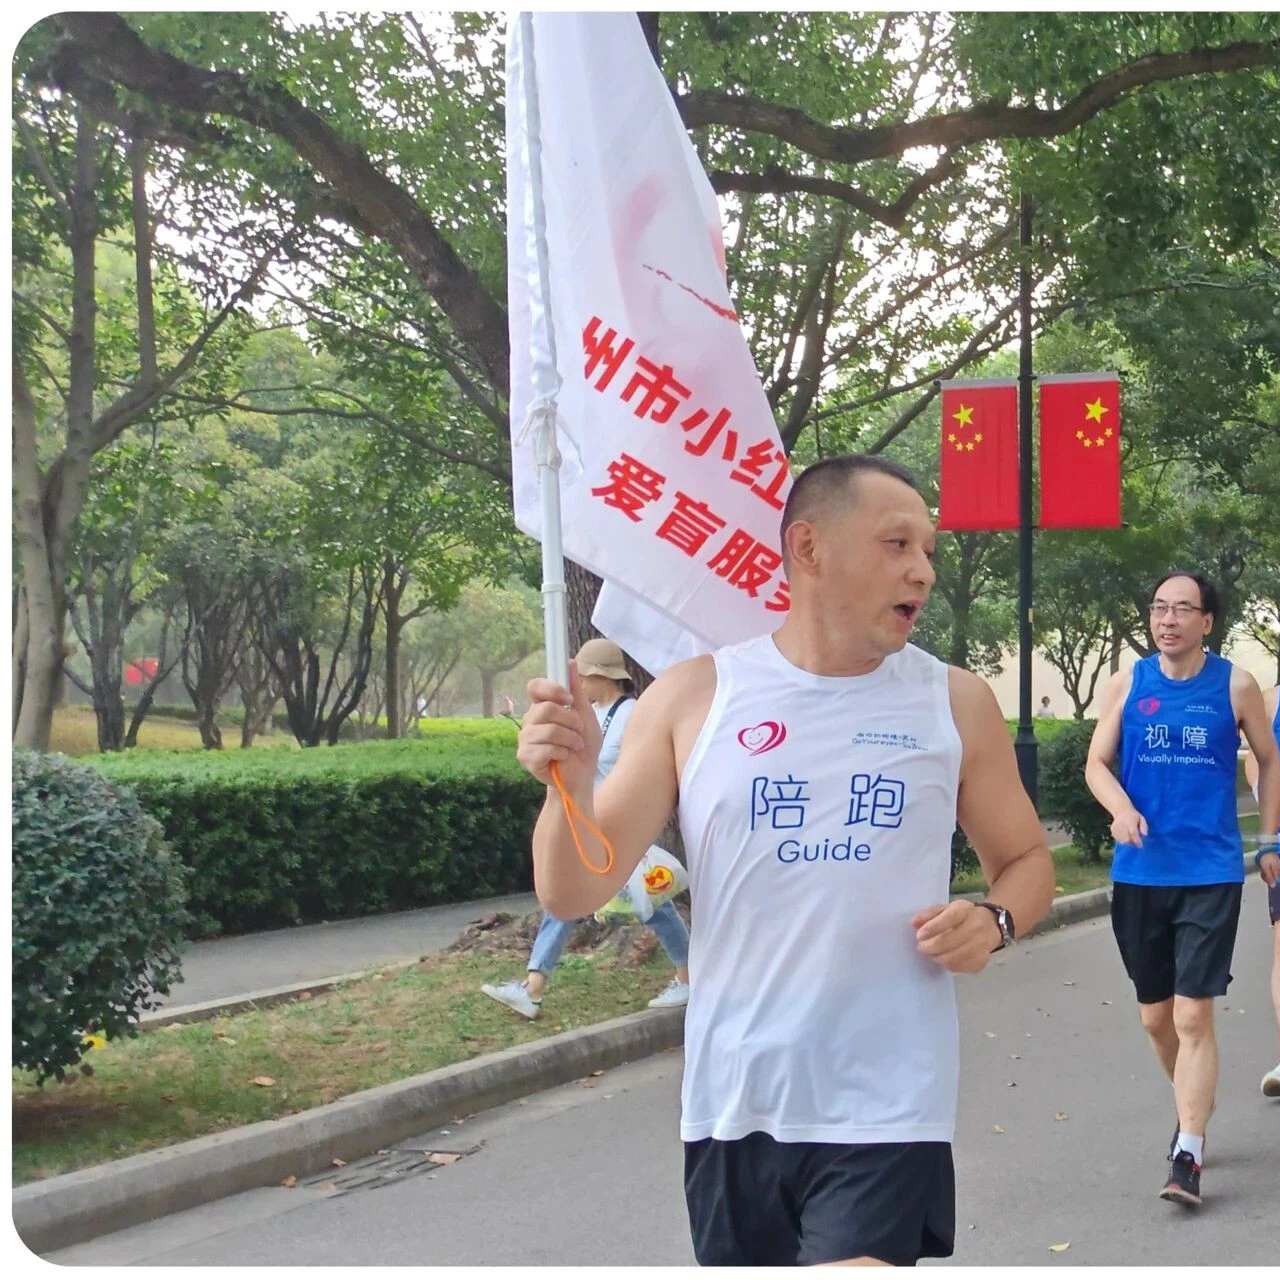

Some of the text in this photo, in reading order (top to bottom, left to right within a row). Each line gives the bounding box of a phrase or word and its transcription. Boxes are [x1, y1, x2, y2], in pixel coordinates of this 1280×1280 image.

[1138, 753, 1215, 765] Visually Impaired
[777, 836, 871, 863] Guide
